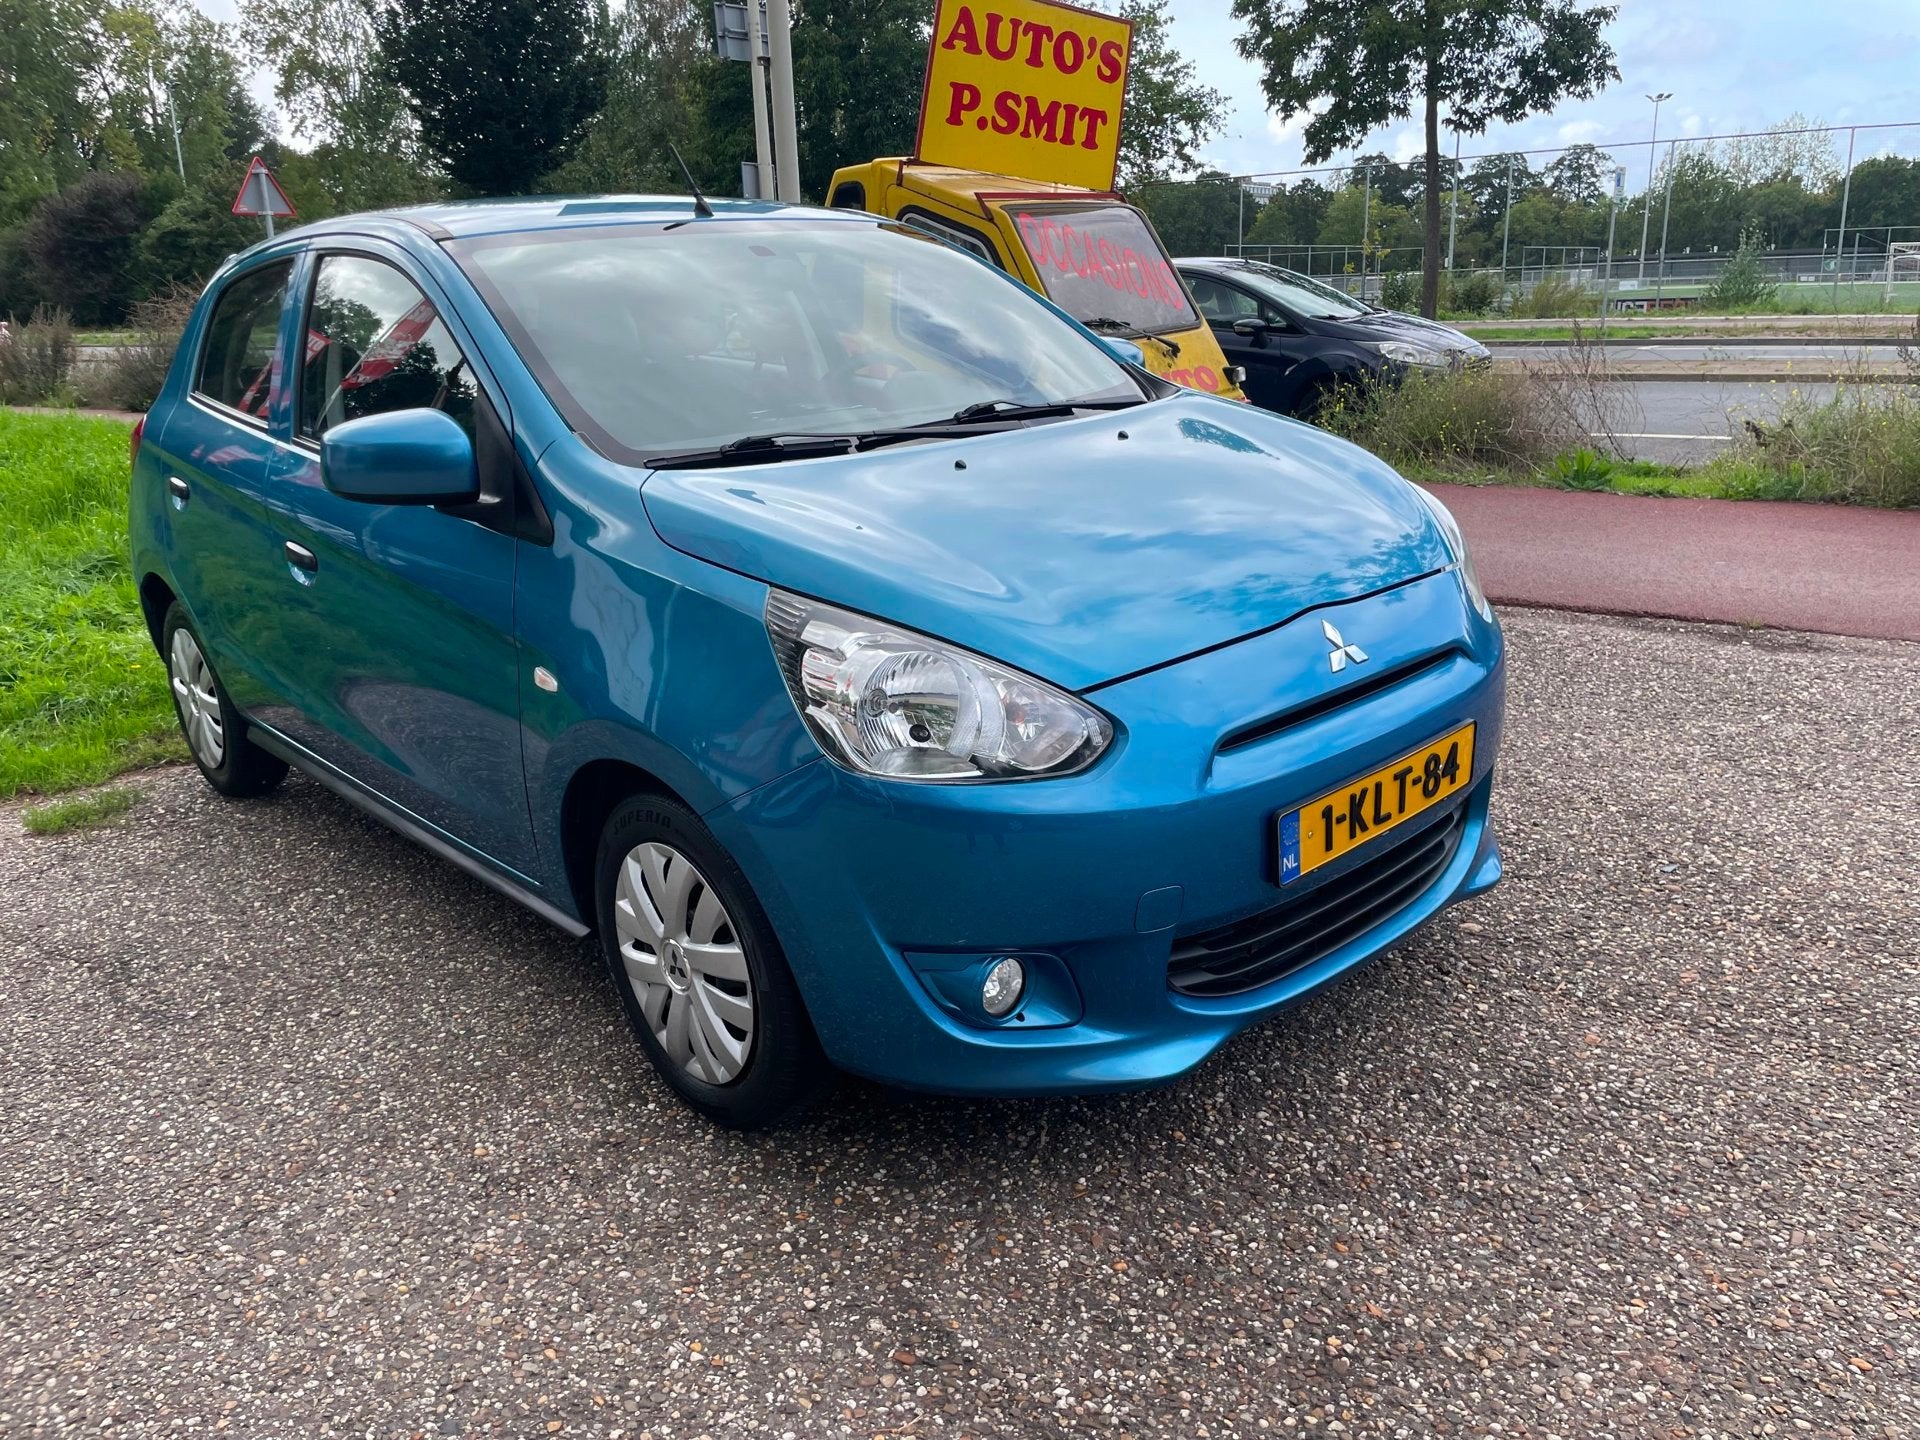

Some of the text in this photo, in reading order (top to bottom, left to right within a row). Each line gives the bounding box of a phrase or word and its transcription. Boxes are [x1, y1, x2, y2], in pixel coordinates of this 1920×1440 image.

[942, 6, 1124, 84] AUTO'S
[945, 81, 1108, 150] P.SMIT
[1018, 212, 1184, 310] OCCASIONS
[1161, 365, 1219, 391] TO
[1322, 742, 1459, 852] 1-KLT-84
[1282, 854, 1298, 873] NL
